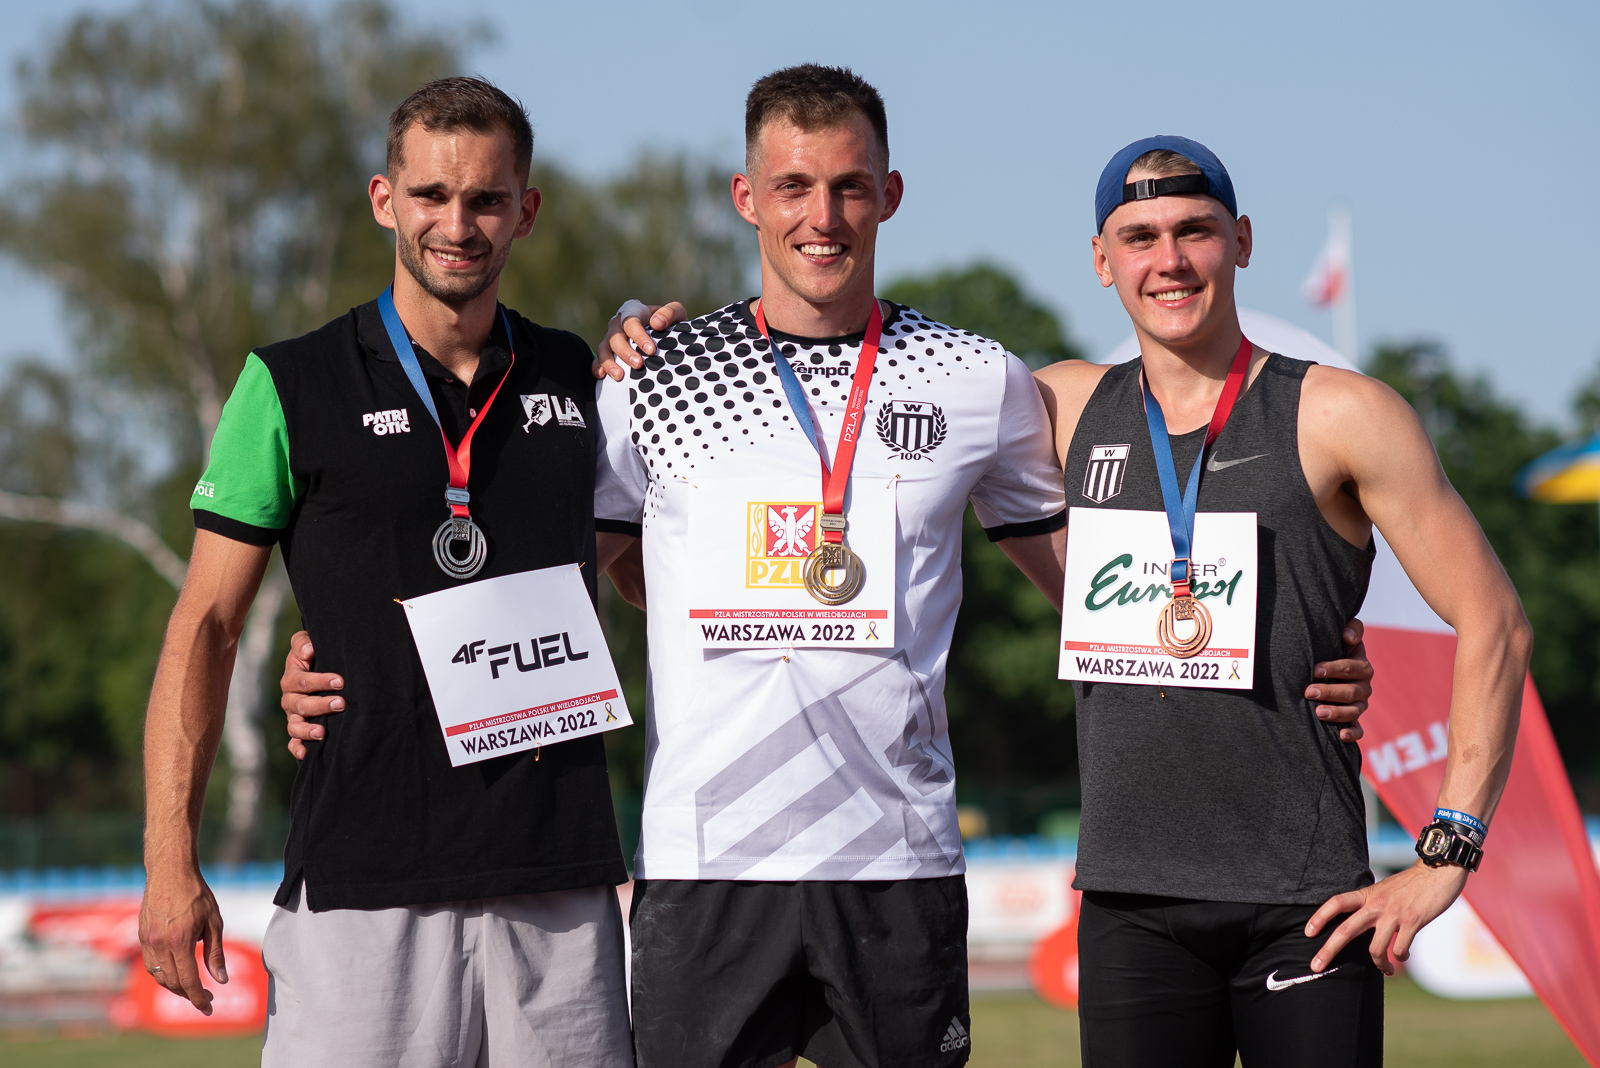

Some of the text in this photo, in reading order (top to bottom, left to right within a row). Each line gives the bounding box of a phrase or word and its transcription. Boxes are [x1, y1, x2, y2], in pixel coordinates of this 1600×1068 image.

[903, 404, 923, 412] W
[362, 408, 409, 427] PATRI
[373, 420, 411, 436] OTIC
[844, 411, 859, 442] PZLA
[900, 452, 922, 461] 100
[1104, 449, 1116, 457] W
[750, 560, 829, 584] PZL
[1143, 562, 1218, 577] INER
[1085, 553, 1243, 610] Eurpol
[815, 611, 867, 619] WIELOBOJACH
[701, 624, 855, 641] WARSZAWA 2022
[1089, 644, 1105, 652] PZLA
[1106, 645, 1152, 654] MISTRZOSTWA
[1075, 656, 1219, 680] WARSZAWA 2022
[469, 722, 485, 731] PZLA
[485, 712, 527, 727] MISTRZOSTWA
[528, 707, 549, 717] POLSKI
[556, 695, 601, 710] WIELOBOJACH
[460, 709, 597, 756] WARSZAWA 2022
[941, 1036, 969, 1052] adida
